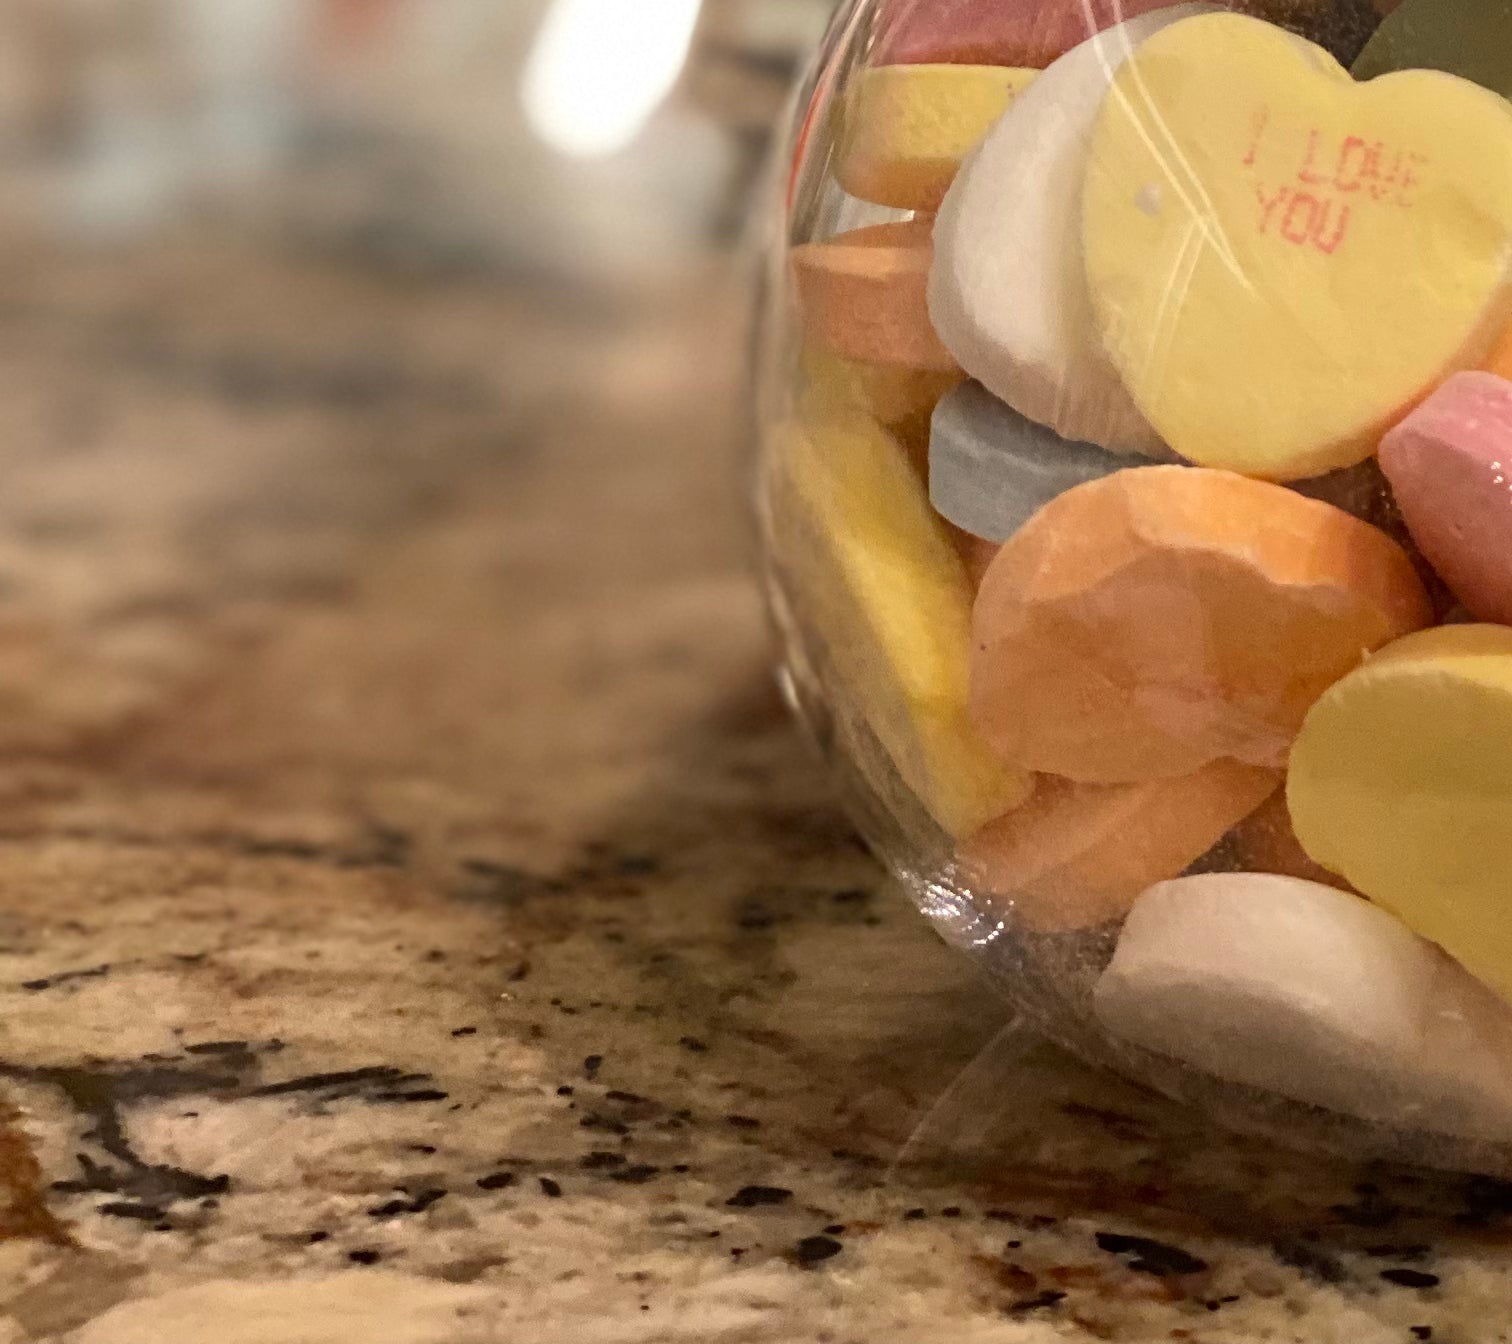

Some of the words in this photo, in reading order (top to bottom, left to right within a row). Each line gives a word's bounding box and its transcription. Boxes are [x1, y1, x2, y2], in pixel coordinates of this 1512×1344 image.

[1242, 106, 1271, 166] I
[1297, 128, 1430, 208] LOVE
[1254, 181, 1351, 256] YOU
